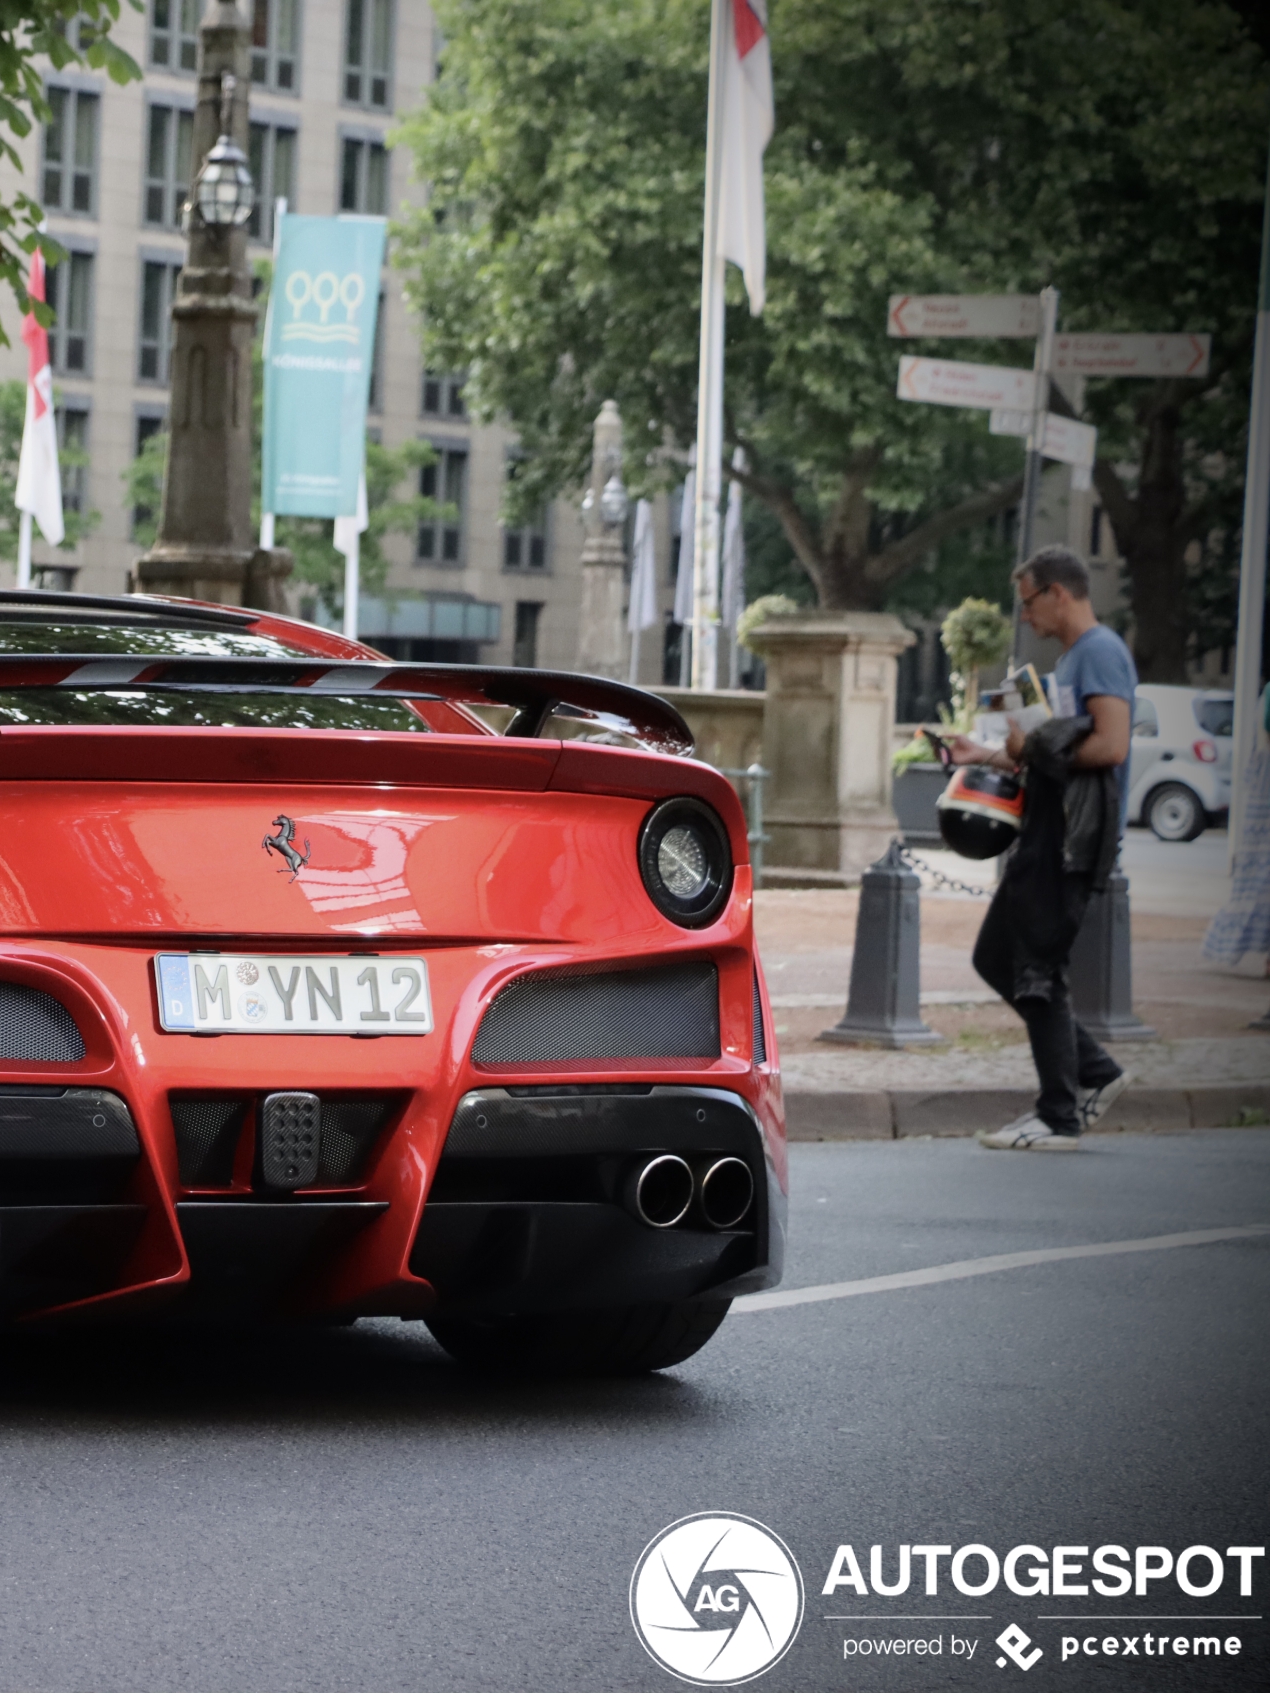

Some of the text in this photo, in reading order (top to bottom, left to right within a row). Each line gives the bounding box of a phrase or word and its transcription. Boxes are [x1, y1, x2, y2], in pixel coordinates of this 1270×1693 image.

[171, 1000, 183, 1016] D
[194, 964, 232, 1020] M
[267, 965, 343, 1021] YN
[357, 966, 425, 1022] 12
